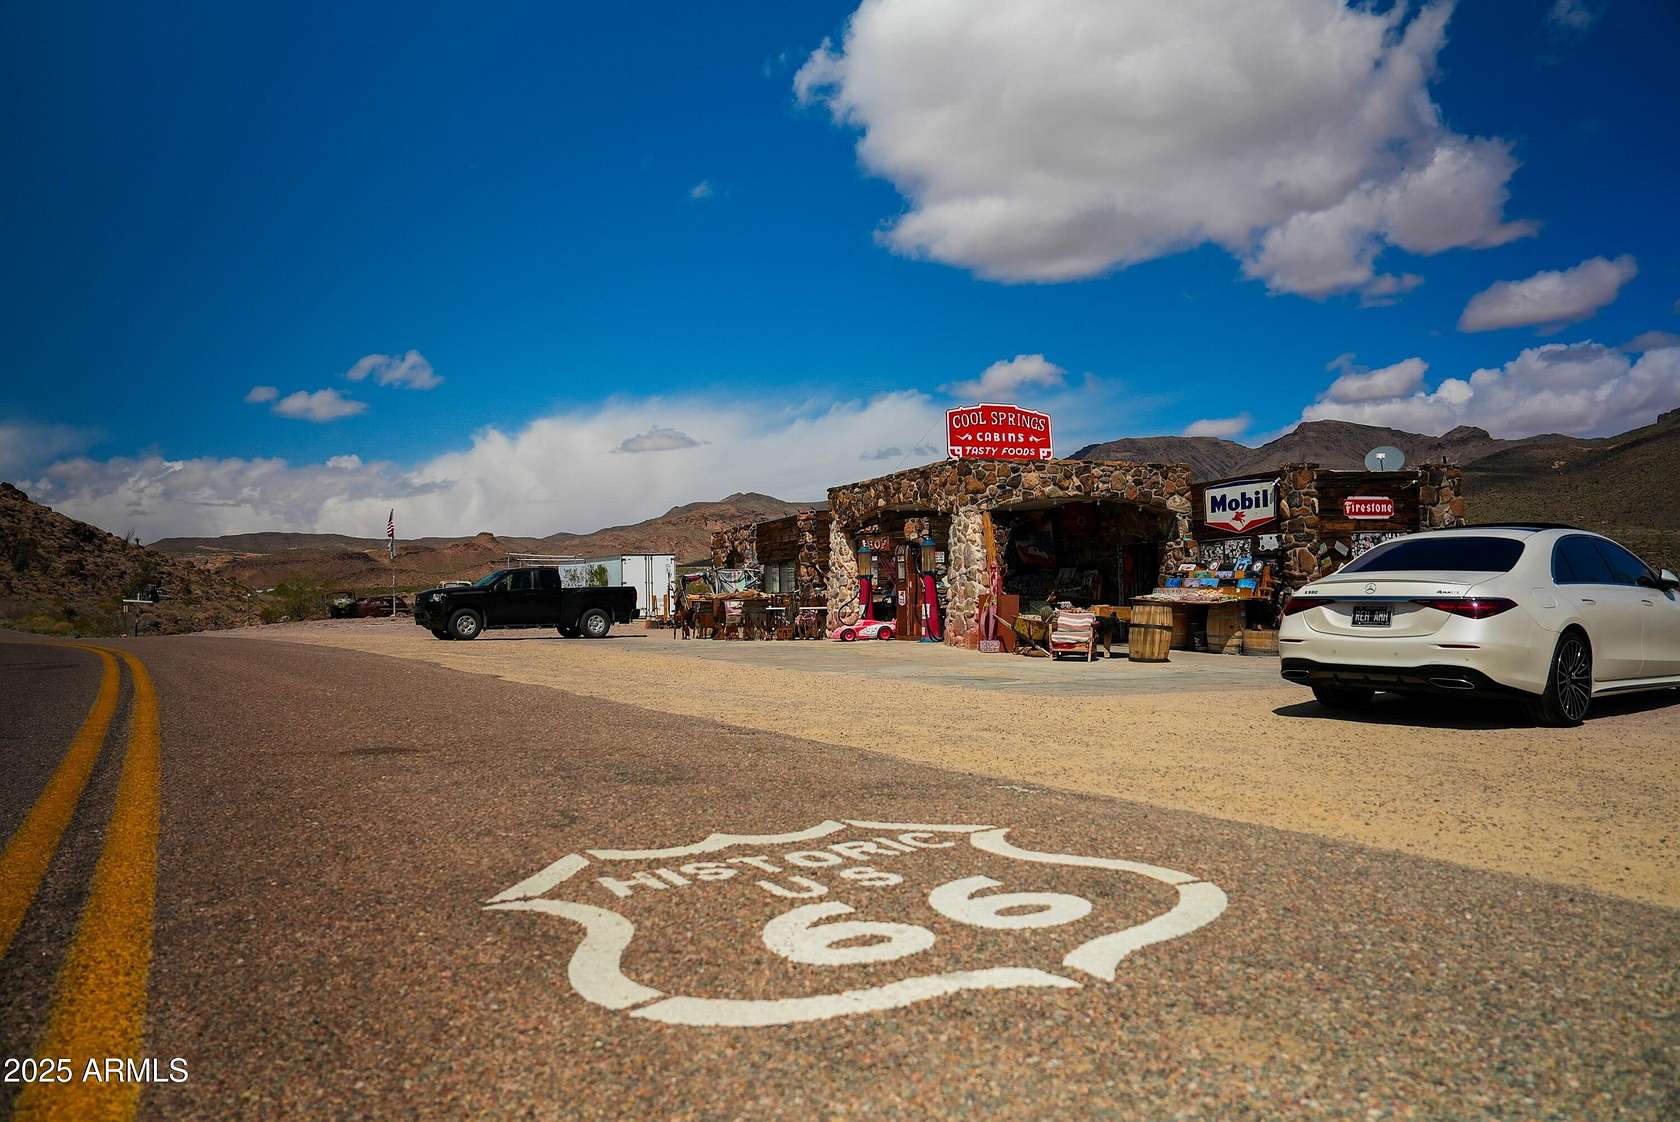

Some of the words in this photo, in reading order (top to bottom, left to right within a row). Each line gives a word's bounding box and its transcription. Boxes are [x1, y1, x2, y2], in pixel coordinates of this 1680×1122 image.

[952, 411, 986, 429] COOL
[990, 411, 1046, 432] SPRINGS
[976, 432, 1024, 442] CABINS
[965, 446, 998, 456] TASTY
[1001, 447, 1036, 456] FOODS
[1210, 489, 1269, 513] Mobil
[1343, 502, 1393, 515] Firestone
[596, 832, 954, 898] HISTORIC
[756, 866, 903, 898] US
[762, 875, 1093, 965] 66
